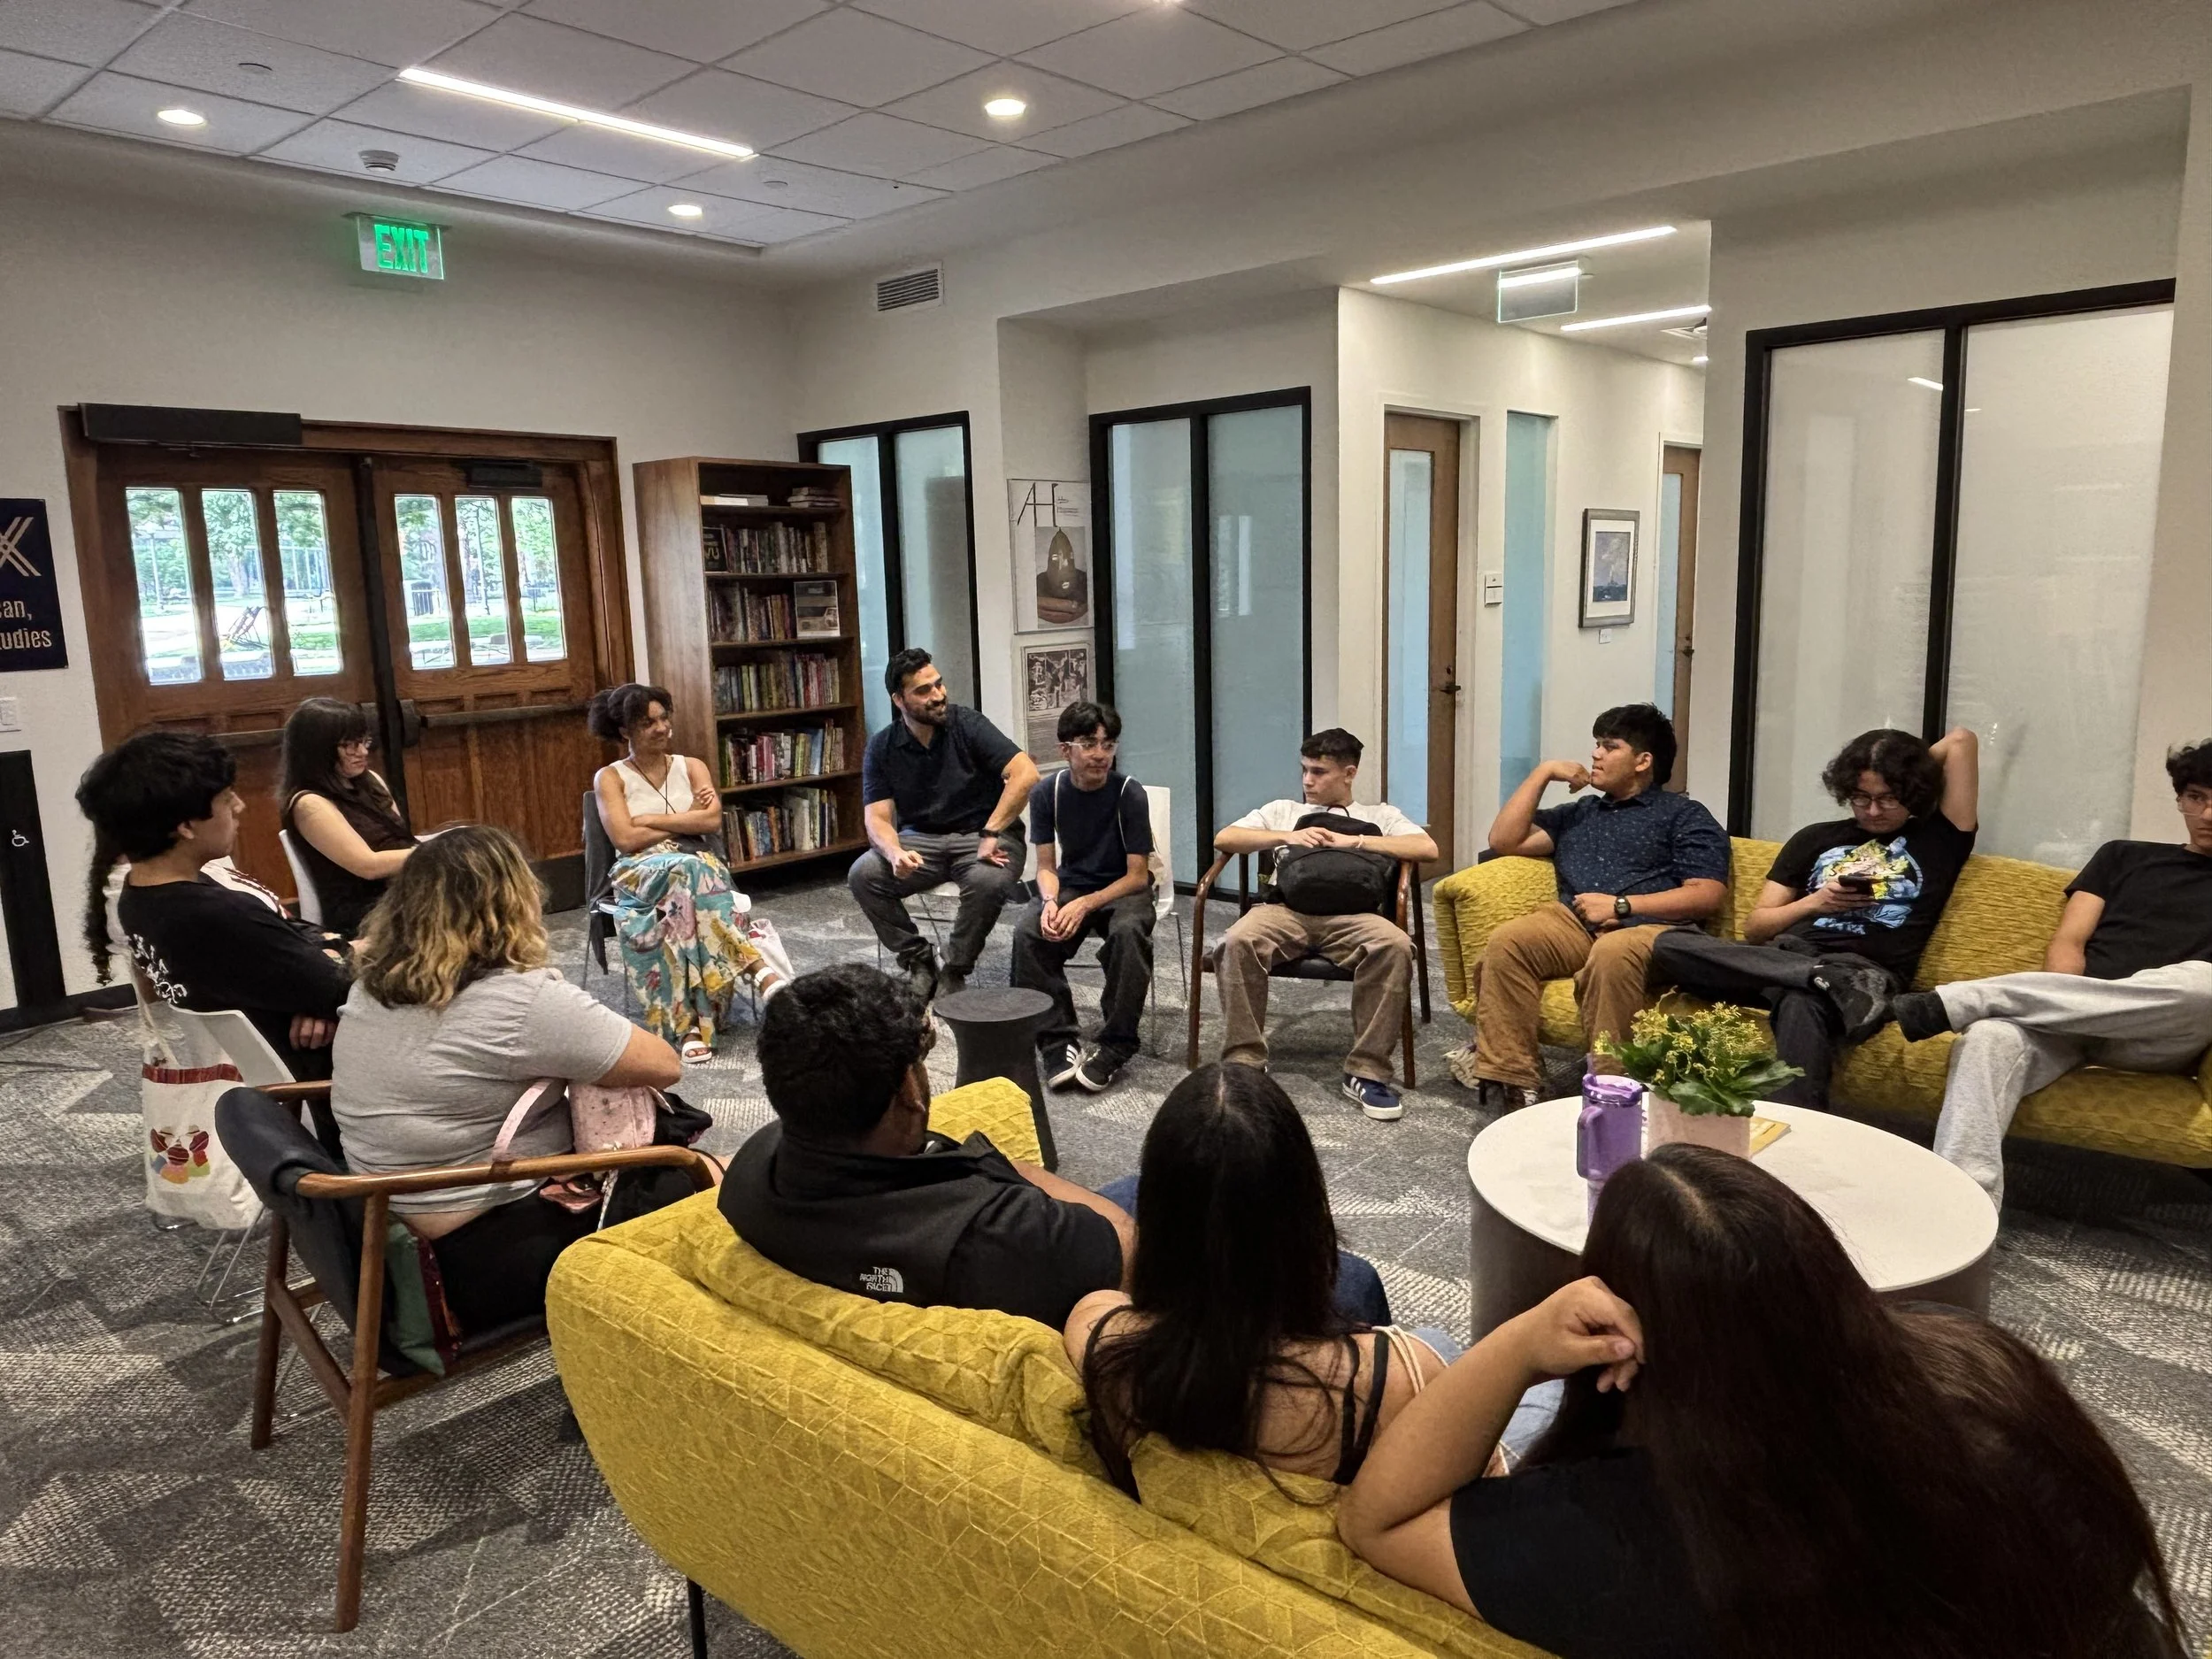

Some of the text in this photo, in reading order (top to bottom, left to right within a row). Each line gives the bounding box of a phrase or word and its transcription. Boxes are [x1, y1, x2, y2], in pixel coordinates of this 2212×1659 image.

[373, 224, 429, 274] EXIT
[0, 600, 33, 621] an,
[0, 627, 52, 650] udies
